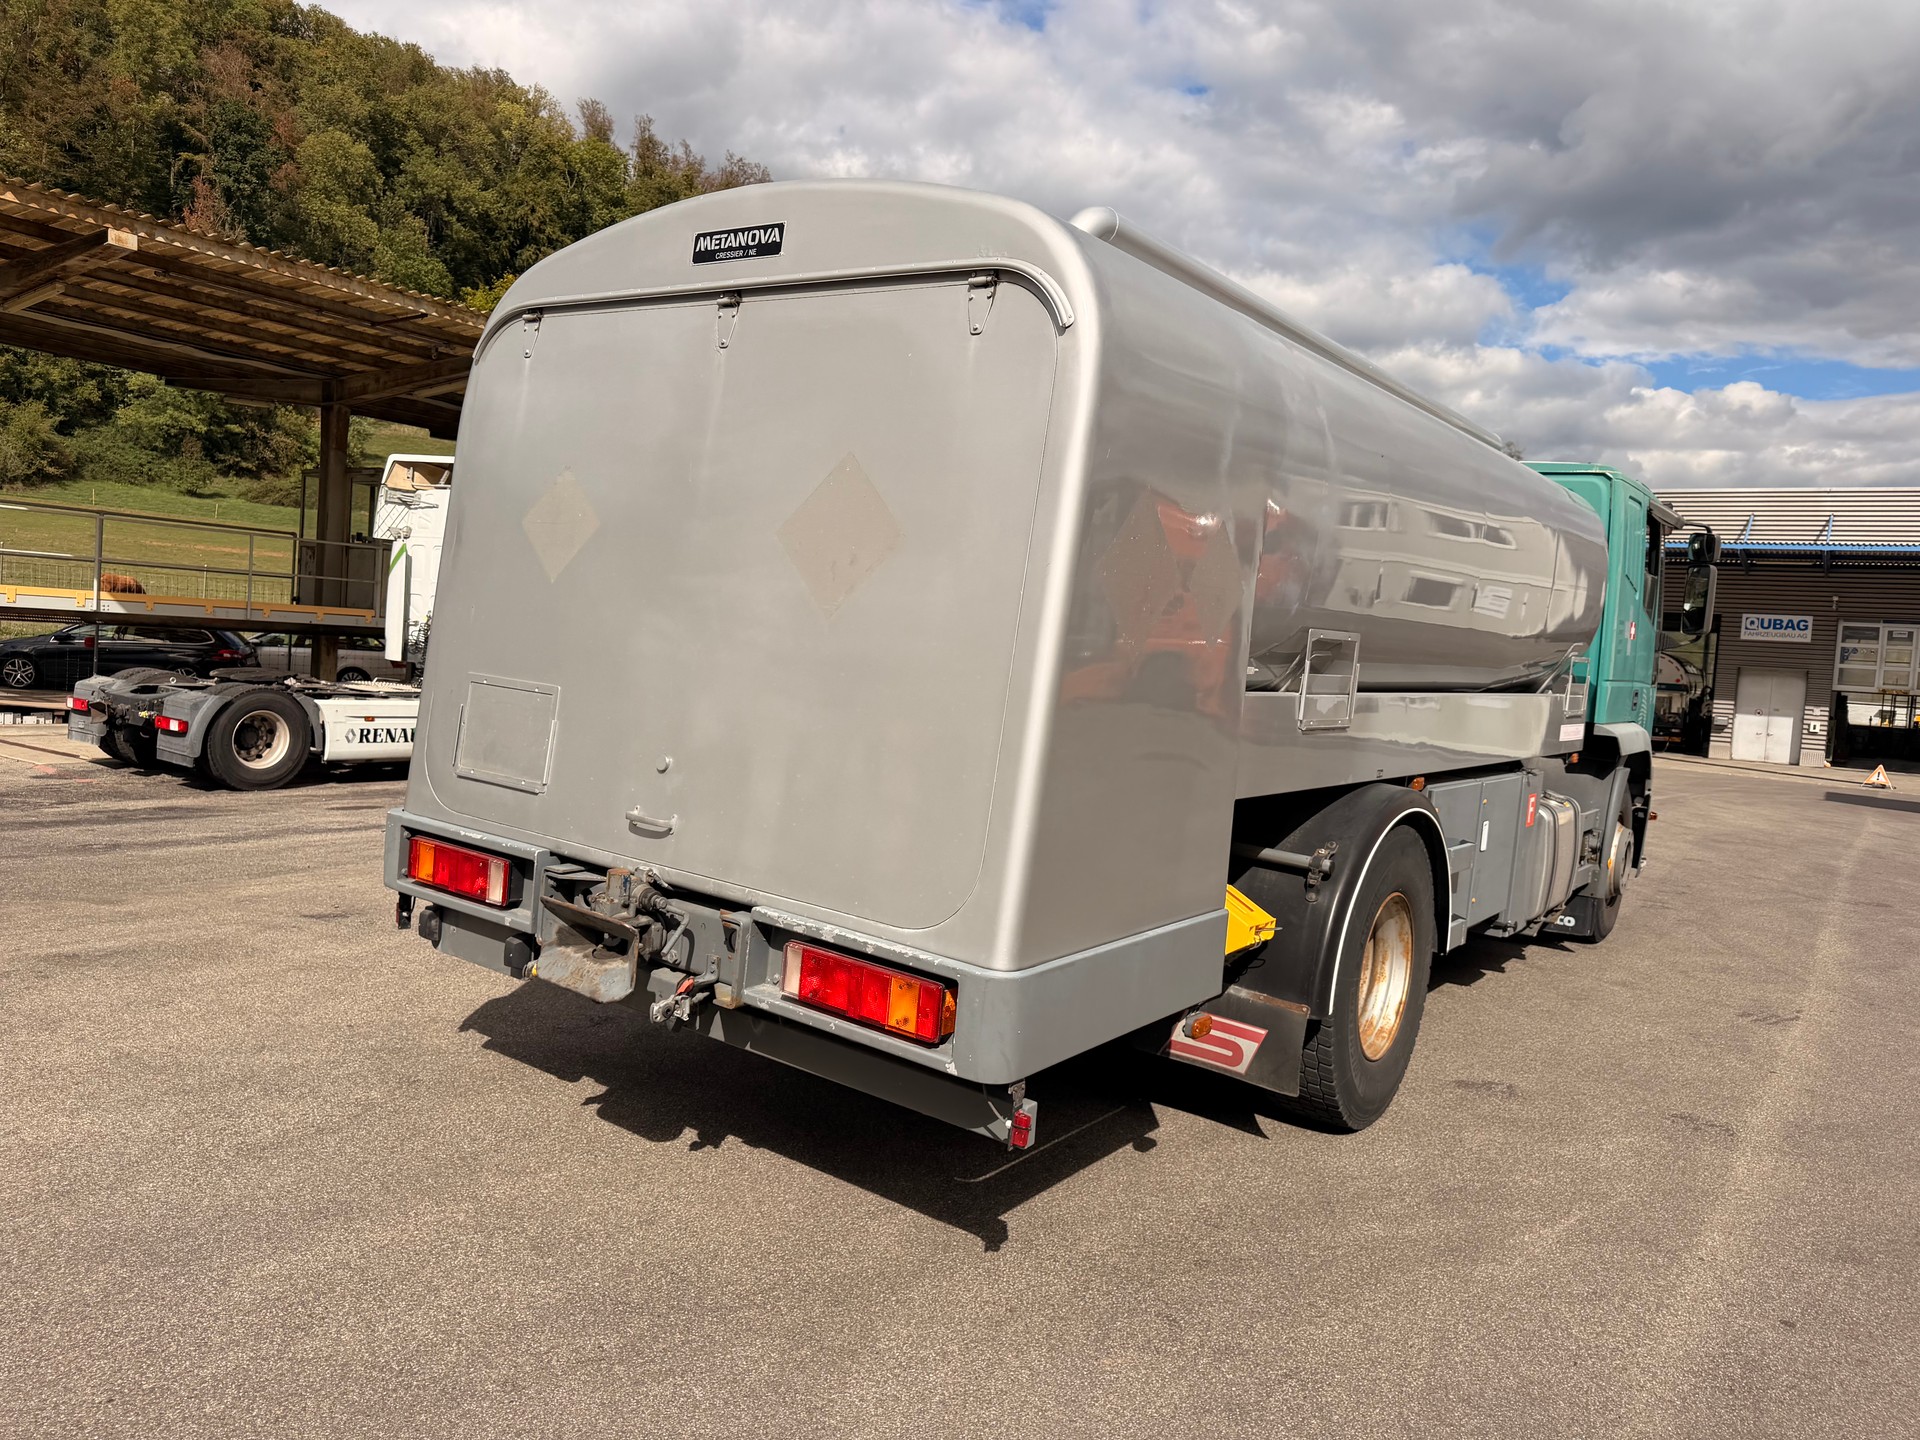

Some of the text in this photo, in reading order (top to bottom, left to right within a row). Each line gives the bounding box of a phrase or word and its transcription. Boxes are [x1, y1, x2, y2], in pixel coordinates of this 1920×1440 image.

[695, 227, 781, 252] METANOVA
[715, 250, 743, 260] CRESSIER
[1745, 616, 1808, 631] QUBAG
[1556, 915, 1576, 927] CO
